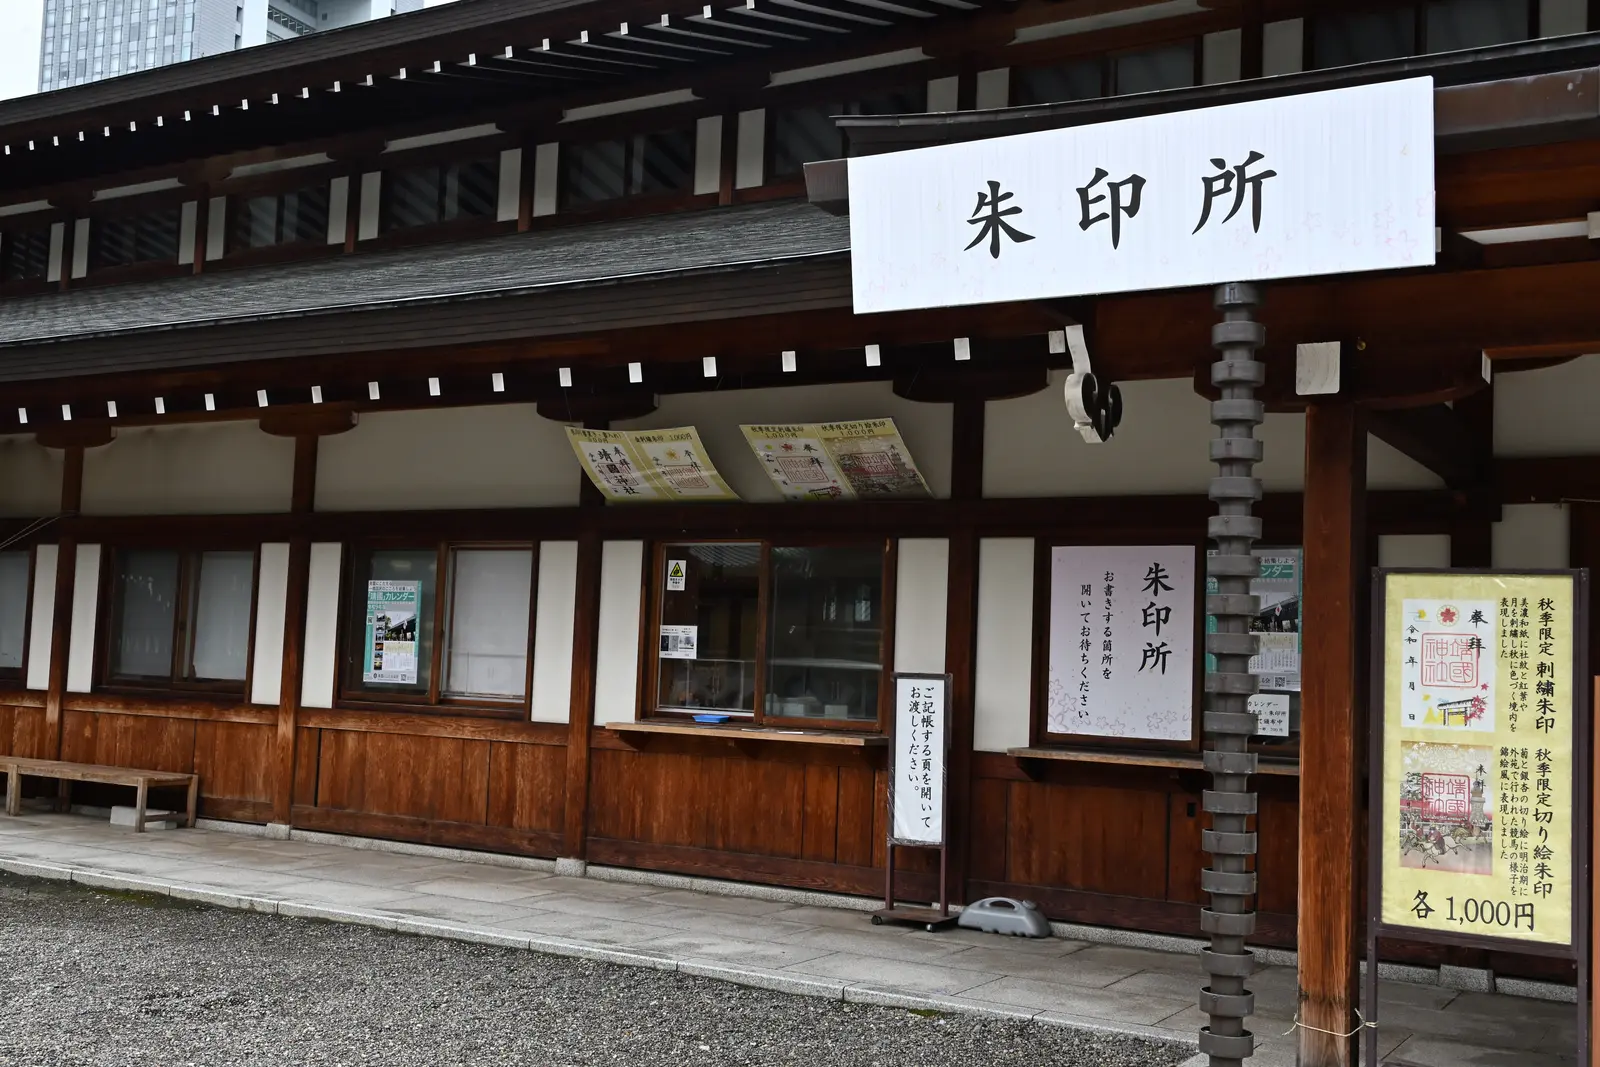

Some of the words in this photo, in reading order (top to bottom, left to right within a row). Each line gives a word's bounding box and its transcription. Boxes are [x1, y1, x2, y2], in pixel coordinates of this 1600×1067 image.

[963, 150, 1278, 260] 朱印所
[1077, 583, 1092, 719] 開いてお待ちください
[1100, 570, 1115, 680] お書きする箇所を
[1137, 562, 1175, 676] 朱印所
[1499, 597, 1510, 658] 表現しました
[908, 686, 921, 791] お渡しください。
[920, 686, 936, 829] ご記帳する頁を開いて
[1509, 747, 1520, 896] 外苑で行われた競馬の様子を
[1519, 748, 1529, 897] 菊と銀杏の切り絵に明治期に
[1532, 748, 1555, 899] 秋季限定切り絵朱印
[1410, 889, 1435, 920] 各
[1445, 895, 1535, 932] 1,000円
